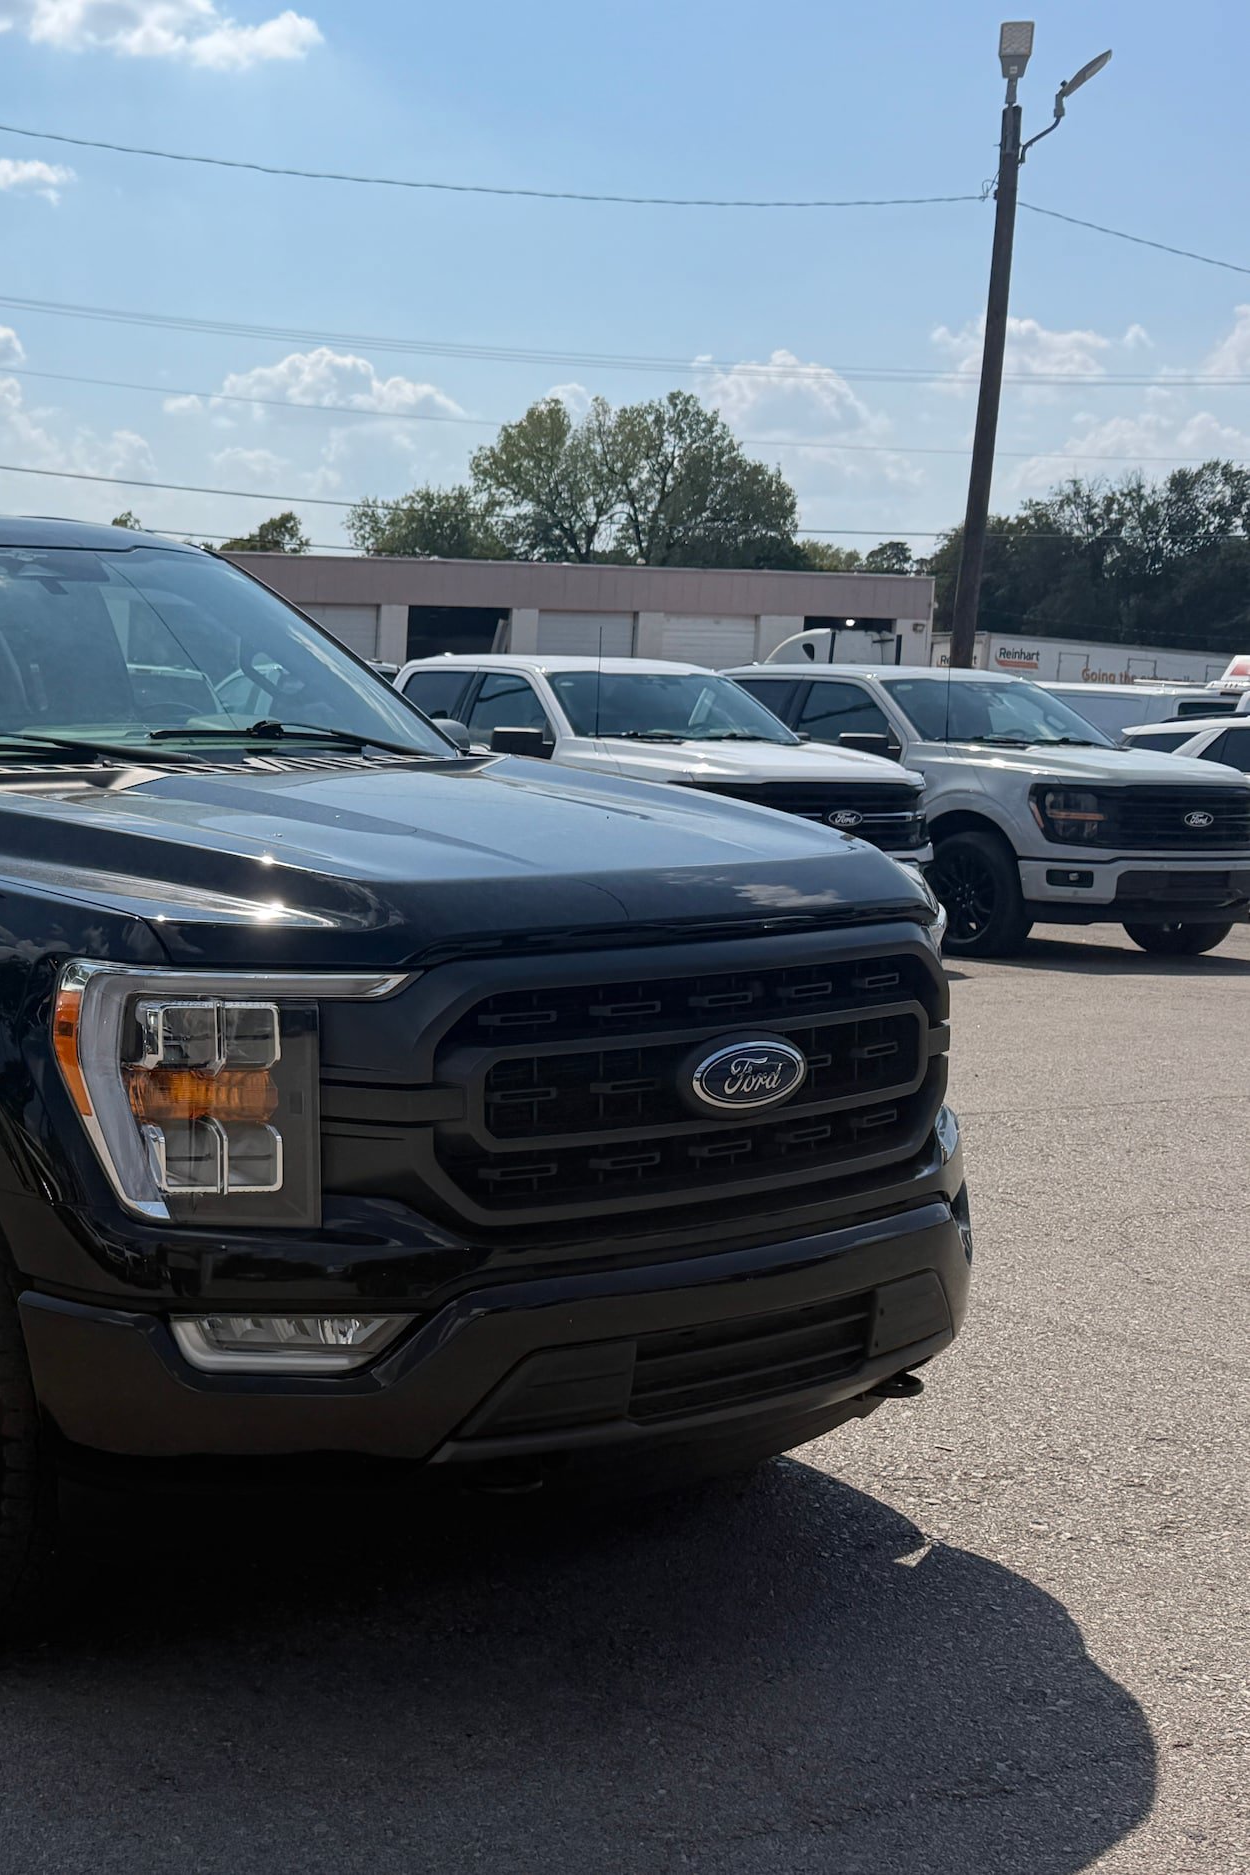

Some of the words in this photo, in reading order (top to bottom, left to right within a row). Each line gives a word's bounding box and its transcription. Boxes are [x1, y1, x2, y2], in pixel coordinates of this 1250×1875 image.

[999, 647, 1040, 661] Reinhart
[1081, 668, 1116, 684] Going
[724, 1056, 784, 1094] Ford
